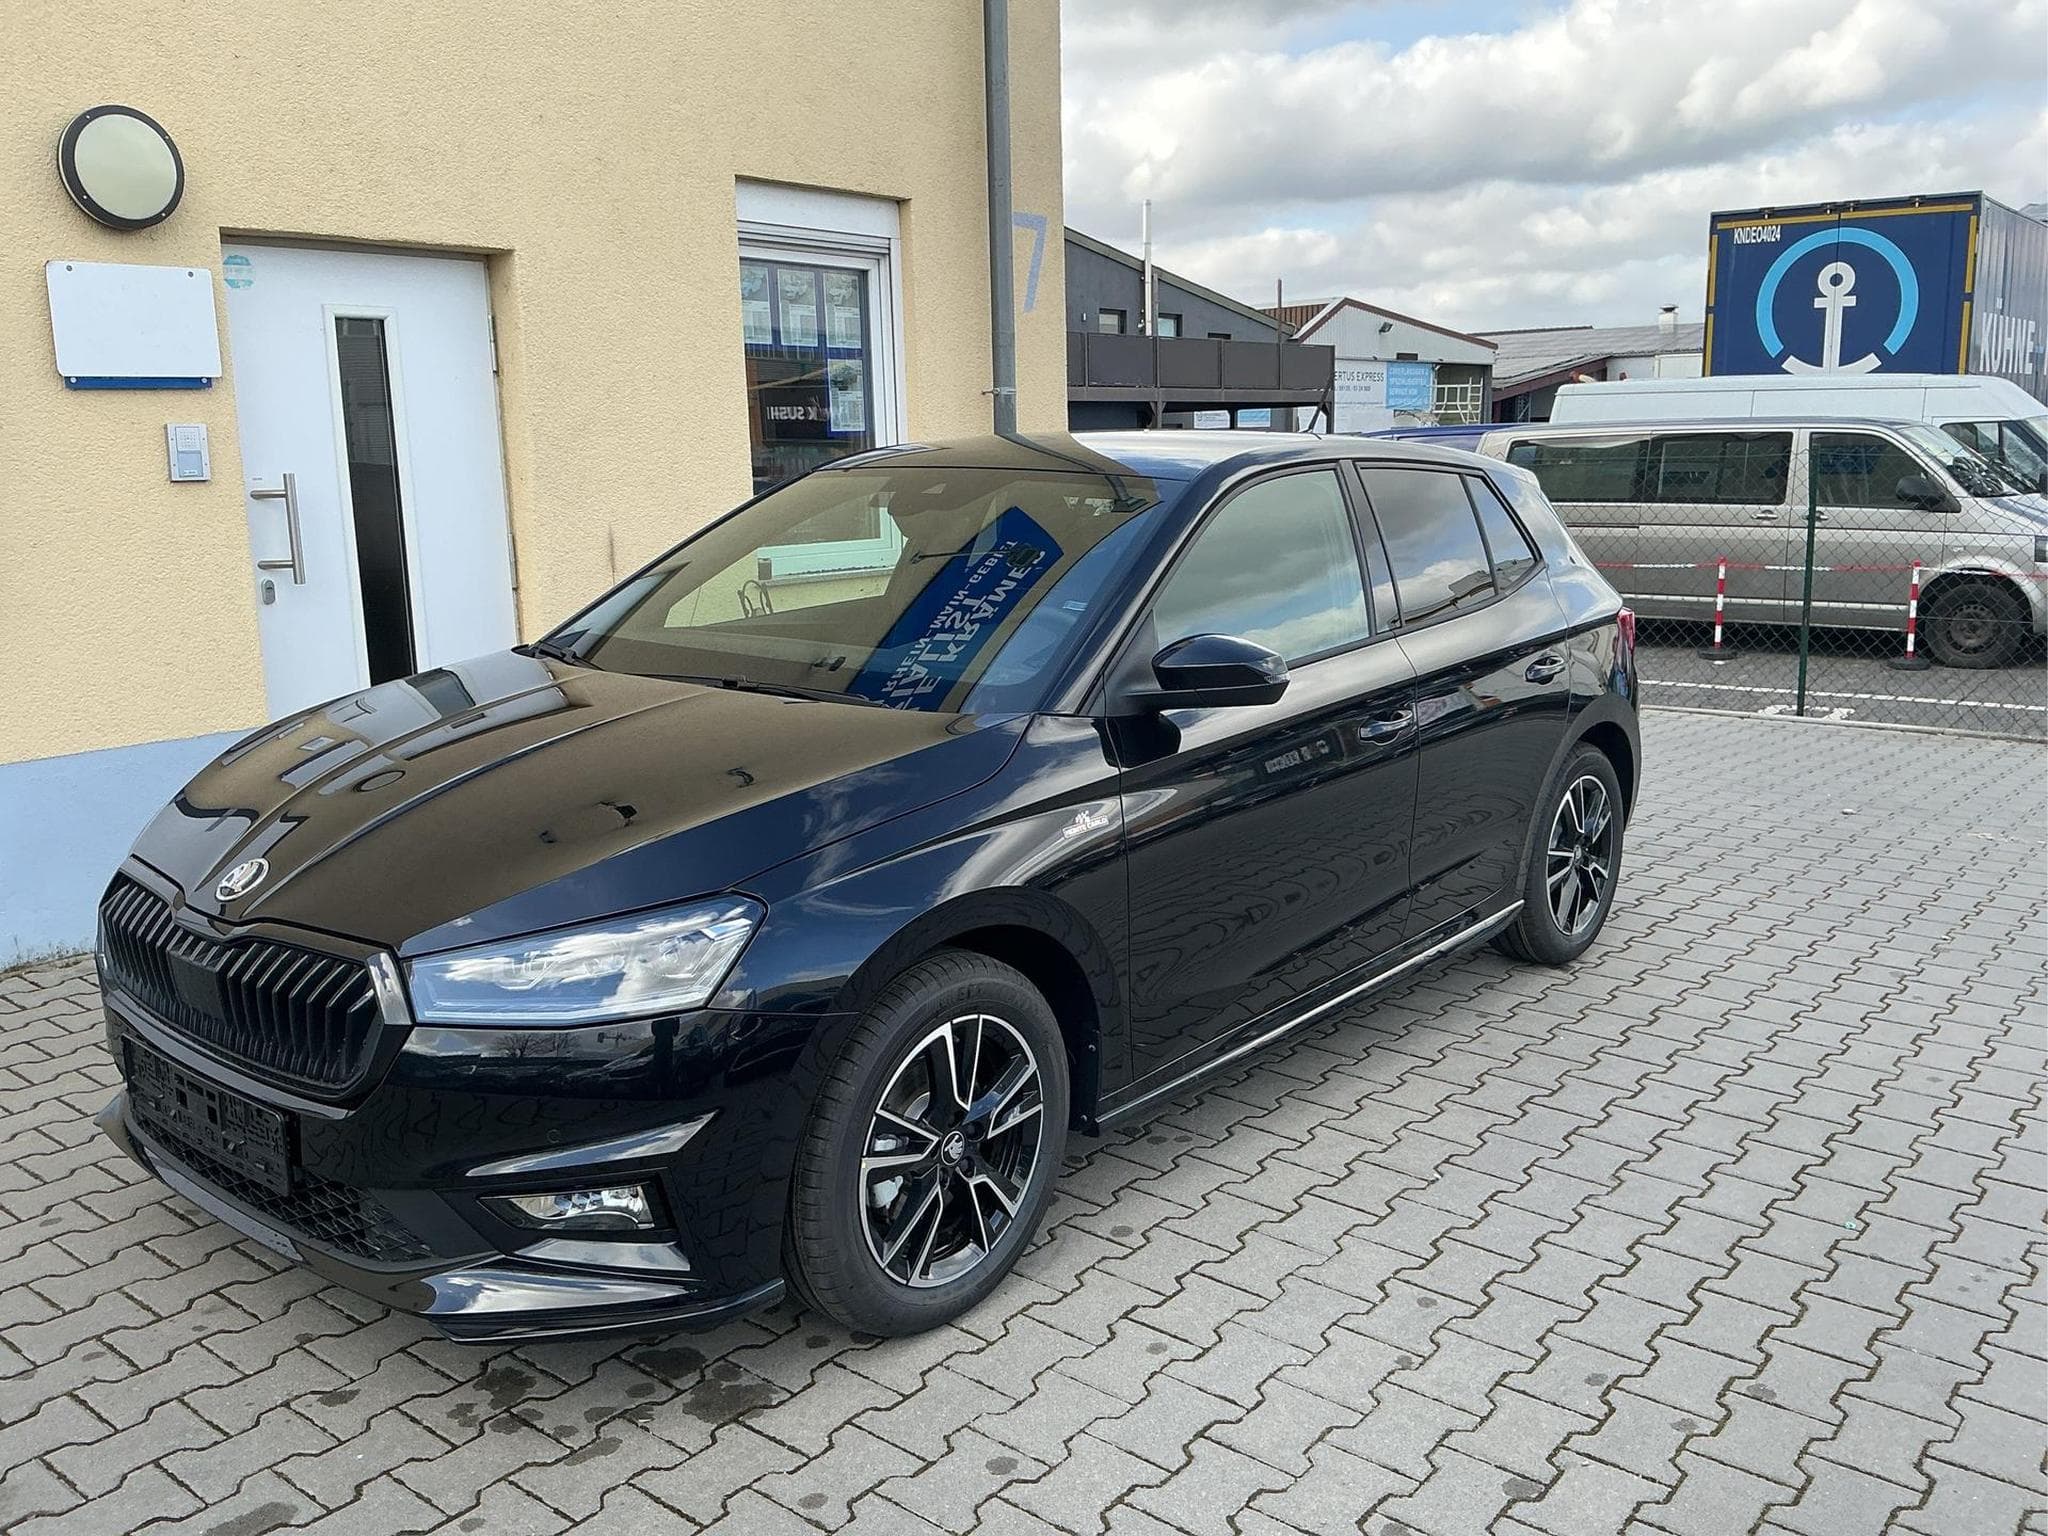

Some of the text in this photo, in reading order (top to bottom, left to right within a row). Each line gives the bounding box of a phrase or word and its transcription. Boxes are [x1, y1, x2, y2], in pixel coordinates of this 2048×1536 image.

[1012, 211, 1047, 312] 7
[1980, 297, 2036, 375] KÜHNE
[1357, 371, 1384, 382] EXPRESS
